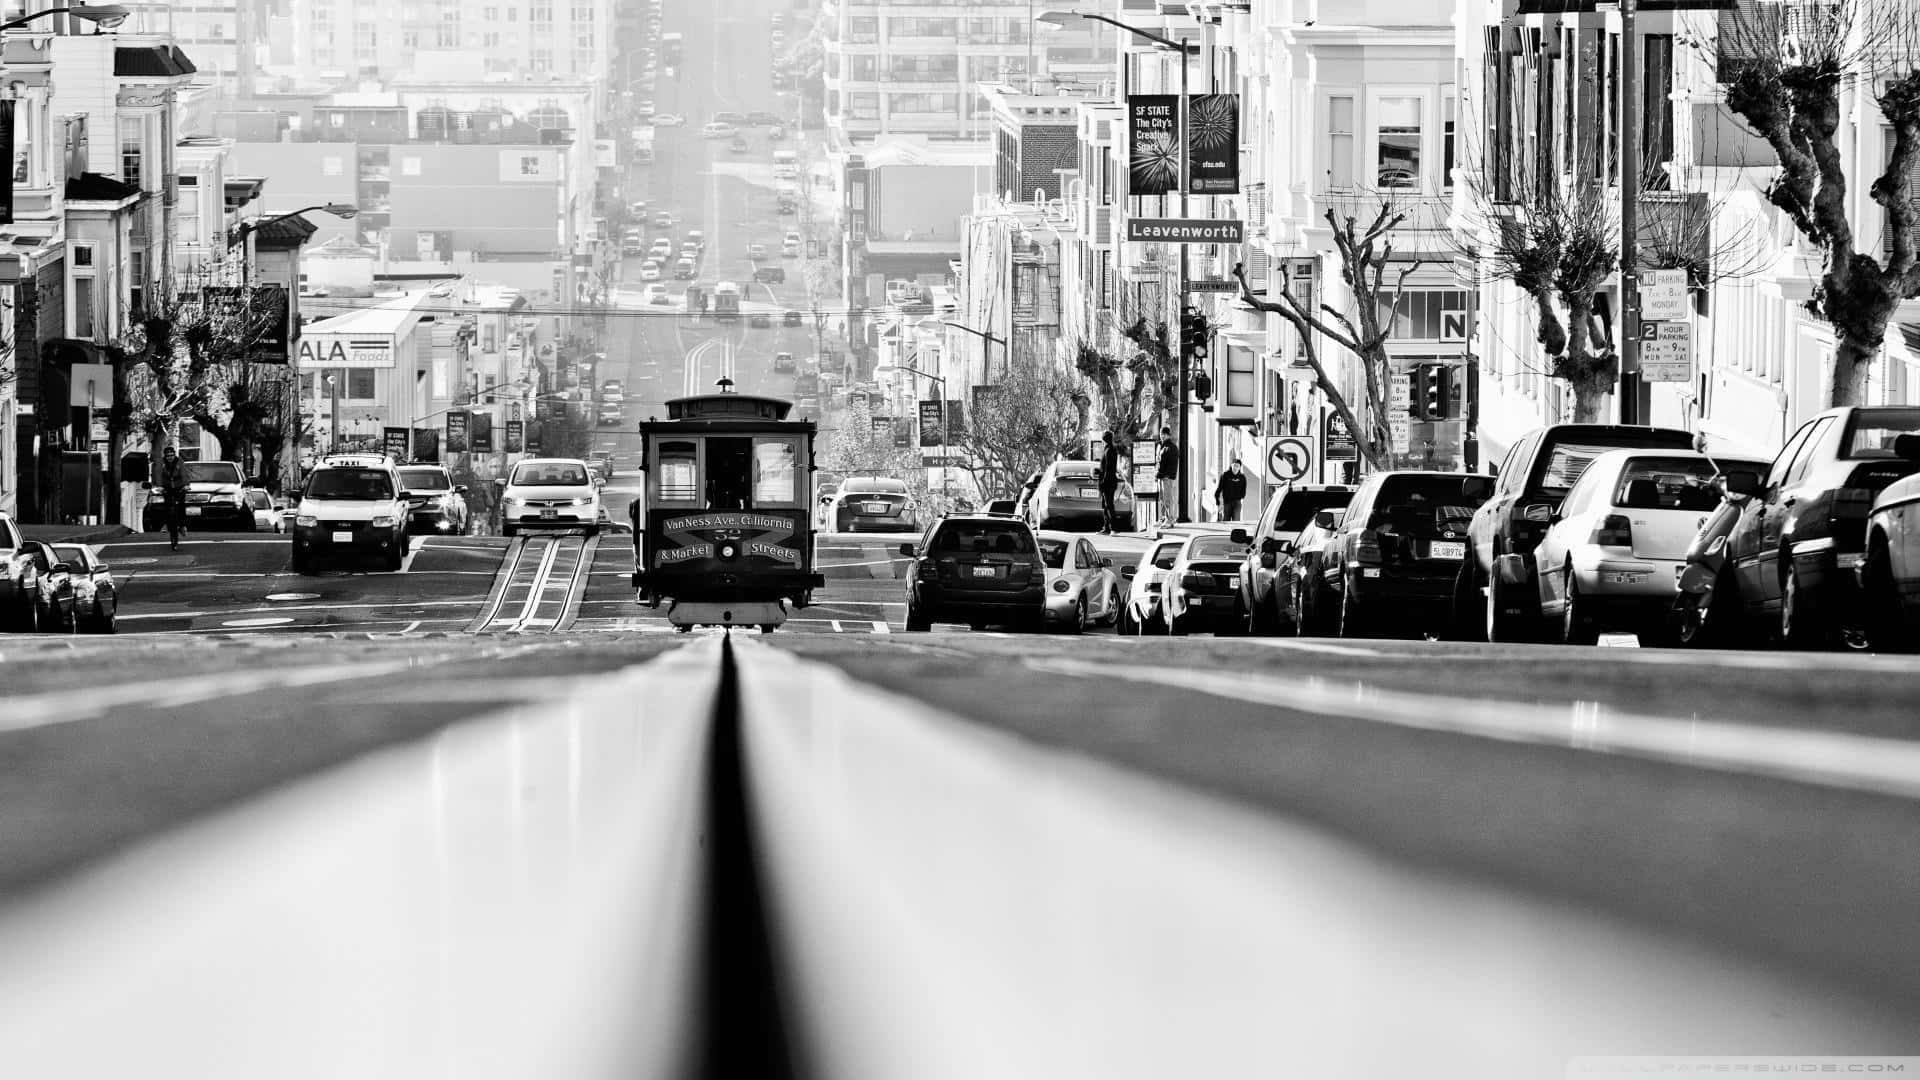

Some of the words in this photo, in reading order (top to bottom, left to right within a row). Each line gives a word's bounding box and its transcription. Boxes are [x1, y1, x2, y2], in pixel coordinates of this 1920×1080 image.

[1135, 106, 1146, 116] SF
[1147, 106, 1170, 116] STATE
[1135, 118, 1150, 128] The
[1151, 118, 1173, 129] City's
[1136, 130, 1169, 140] Creative
[1136, 142, 1159, 153] Spark
[1132, 223, 1238, 238] Leavenworth
[1642, 272, 1656, 285] NO
[1657, 275, 1685, 284] PARKING
[1651, 300, 1679, 309] MONDAY
[1444, 314, 1466, 338] N
[1644, 325, 1655, 337] 2
[301, 340, 347, 361] ALA
[353, 350, 390, 361] Foods
[685, 517, 711, 528] Ness
[714, 515, 739, 525] Ave.
[740, 515, 793, 529] California
[661, 550, 669, 560] &
[671, 545, 709, 560] Market
[751, 543, 795, 559] Streets
